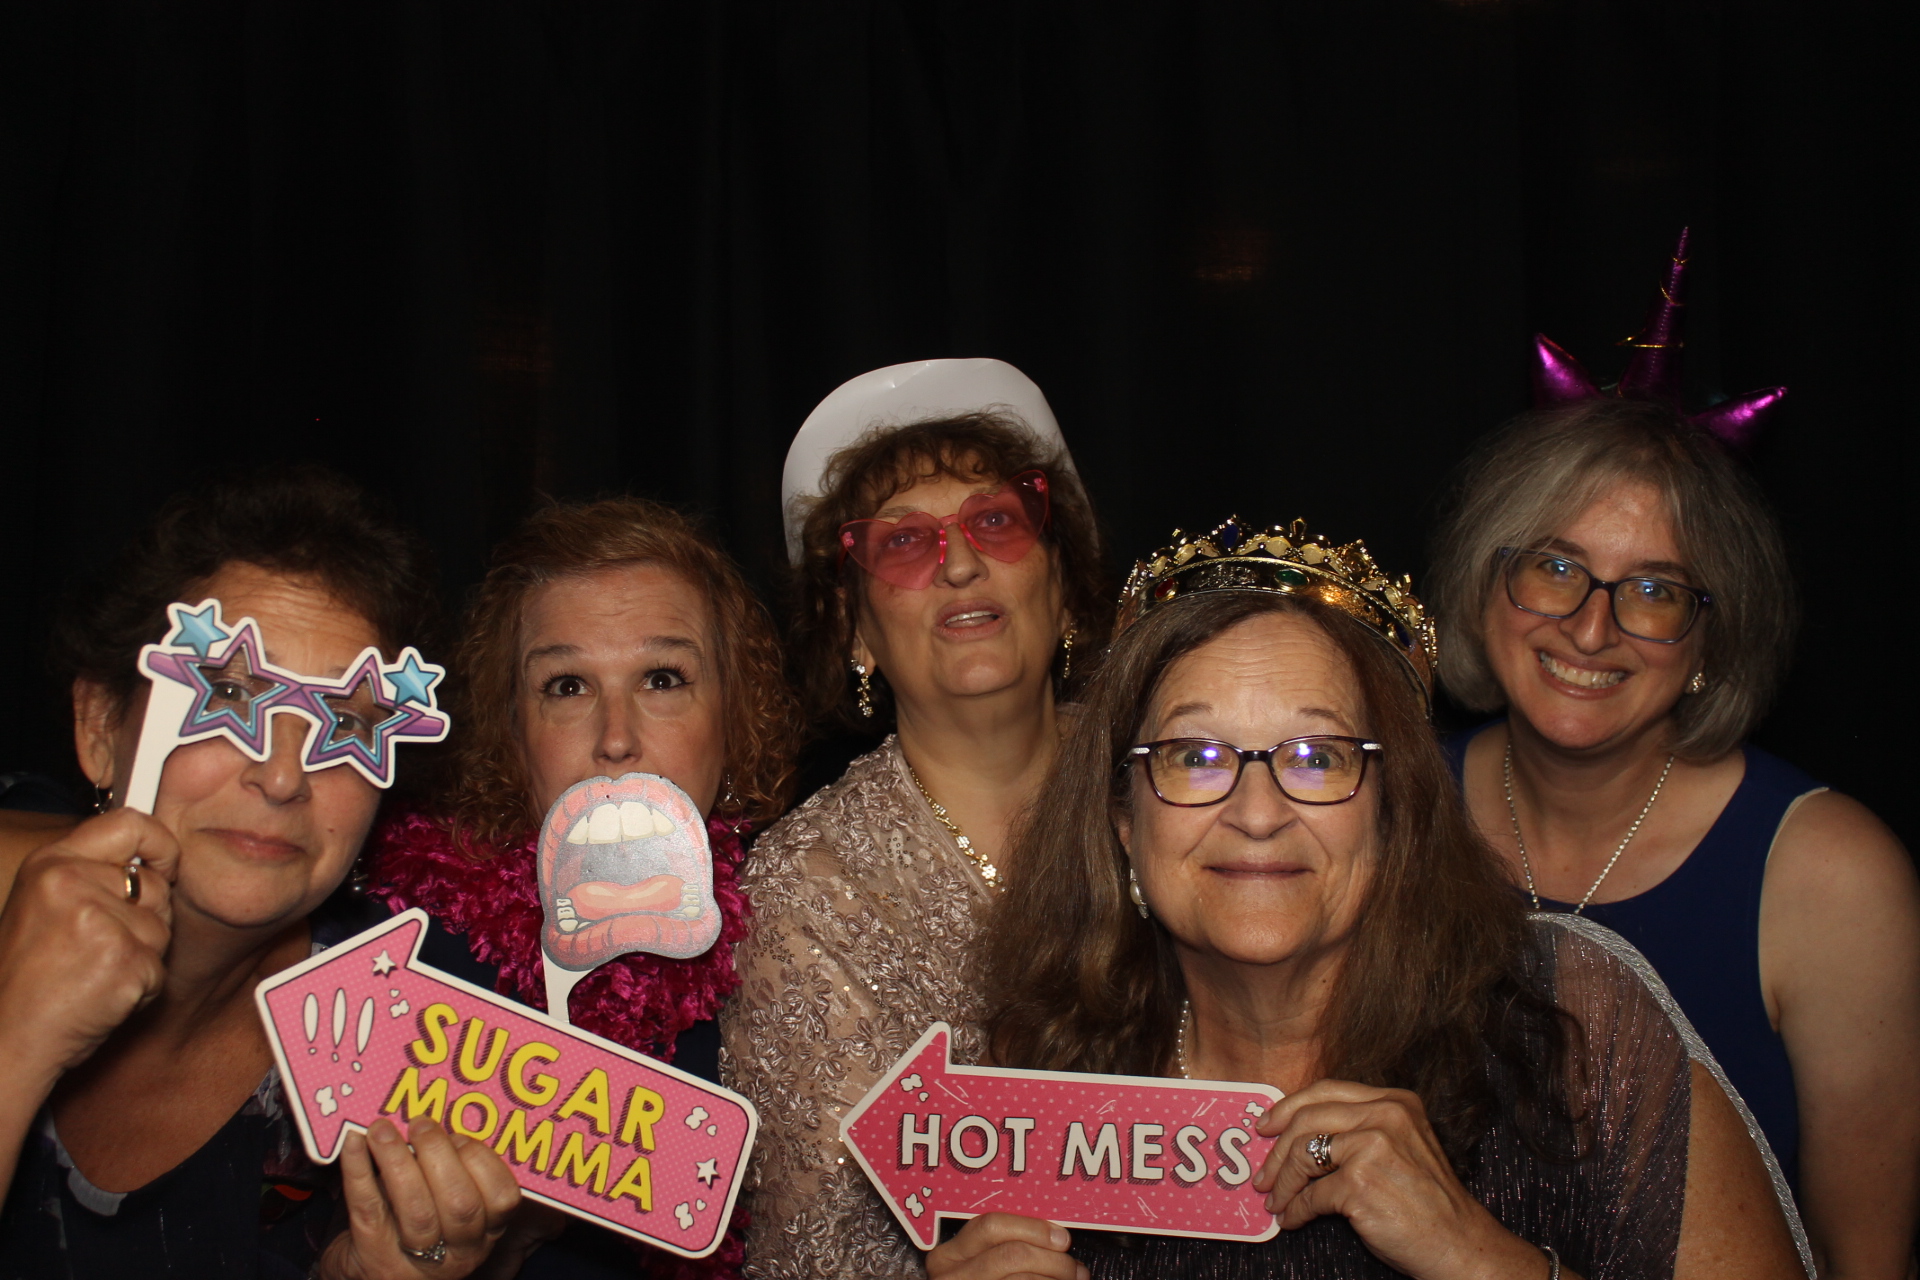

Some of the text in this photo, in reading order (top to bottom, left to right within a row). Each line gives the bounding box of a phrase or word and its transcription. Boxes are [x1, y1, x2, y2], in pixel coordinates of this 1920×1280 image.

[379, 1066, 654, 1214] MOMMA
[404, 1002, 665, 1153] SUGAR
[899, 1112, 1252, 1190] HOT MESS
